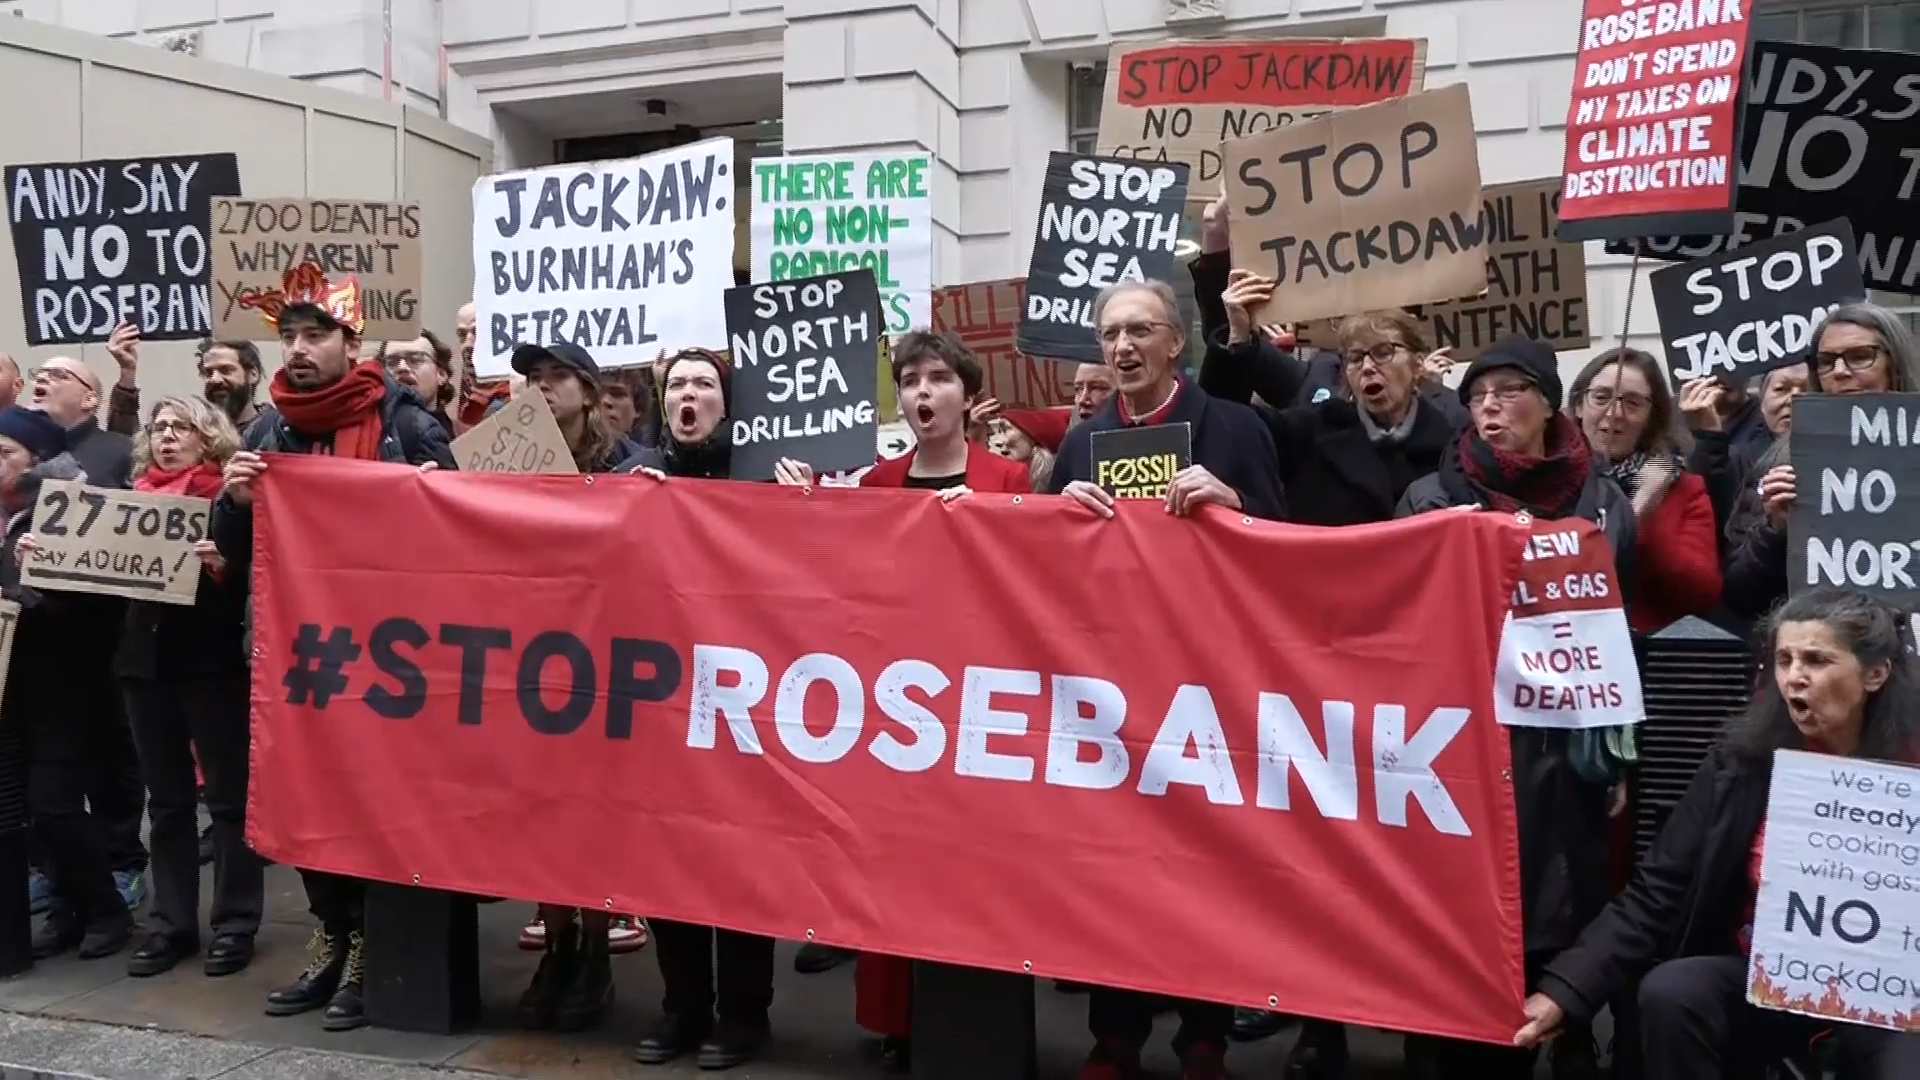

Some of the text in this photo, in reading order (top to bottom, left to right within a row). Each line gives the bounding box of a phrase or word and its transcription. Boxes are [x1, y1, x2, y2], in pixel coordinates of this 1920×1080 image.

[1583, 0, 1743, 50] ROSEBANK
[1124, 52, 1407, 99] STOP JACKDAW
[1584, 39, 1737, 88] DON'T SPEND
[1749, 52, 1873, 116] NDY,
[1576, 75, 1732, 125] MY TAXES ON
[1143, 108, 1192, 140] NO
[1578, 116, 1712, 163] CLIMATE
[14, 161, 199, 223] ANDY, SAY
[755, 158, 928, 203] THERE ARE
[1068, 160, 1175, 204] STOP
[1238, 121, 1438, 216] STOP
[1565, 155, 1727, 199] DESTRUCTION
[218, 200, 420, 238] 2700 DEATHS
[494, 154, 728, 238] JACKDAW:
[774, 204, 909, 245] NO NON-
[1041, 202, 1180, 251] NORTH
[44, 224, 206, 281] NO TO
[230, 239, 399, 275] WHY AREN'T
[491, 238, 694, 295] BURNHAM'S
[1058, 248, 1145, 288] SEA
[1260, 209, 1485, 288] JACKDAW
[1485, 248, 1560, 297] ATH
[1685, 234, 1843, 316] STOP
[35, 283, 212, 340] ROSEBAN
[753, 279, 844, 319] STOP
[1028, 294, 1096, 328] DRIL
[491, 304, 658, 357] BETRAYAL
[732, 311, 868, 369] NORTH
[1433, 298, 1584, 349] NTENCE
[766, 356, 848, 402] SEA
[732, 400, 875, 446] DRILLING
[491, 426, 555, 471] STOP
[1821, 467, 1897, 516] NO
[40, 491, 206, 543] 27 JOBS
[32, 547, 67, 566] SAY
[1807, 536, 1920, 589] NOR
[1545, 582, 1561, 599] &
[1564, 572, 1608, 599] GAS
[1521, 646, 1602, 674] MORE
[1513, 683, 1622, 711] DEATHS
[282, 616, 1473, 837] #STOPROSEBANK
[1830, 768, 1912, 798] We're
[1814, 799, 1920, 834] already
[1799, 859, 1854, 883] with
[1808, 831, 1919, 866] cooking
[1784, 890, 1881, 944] NO
